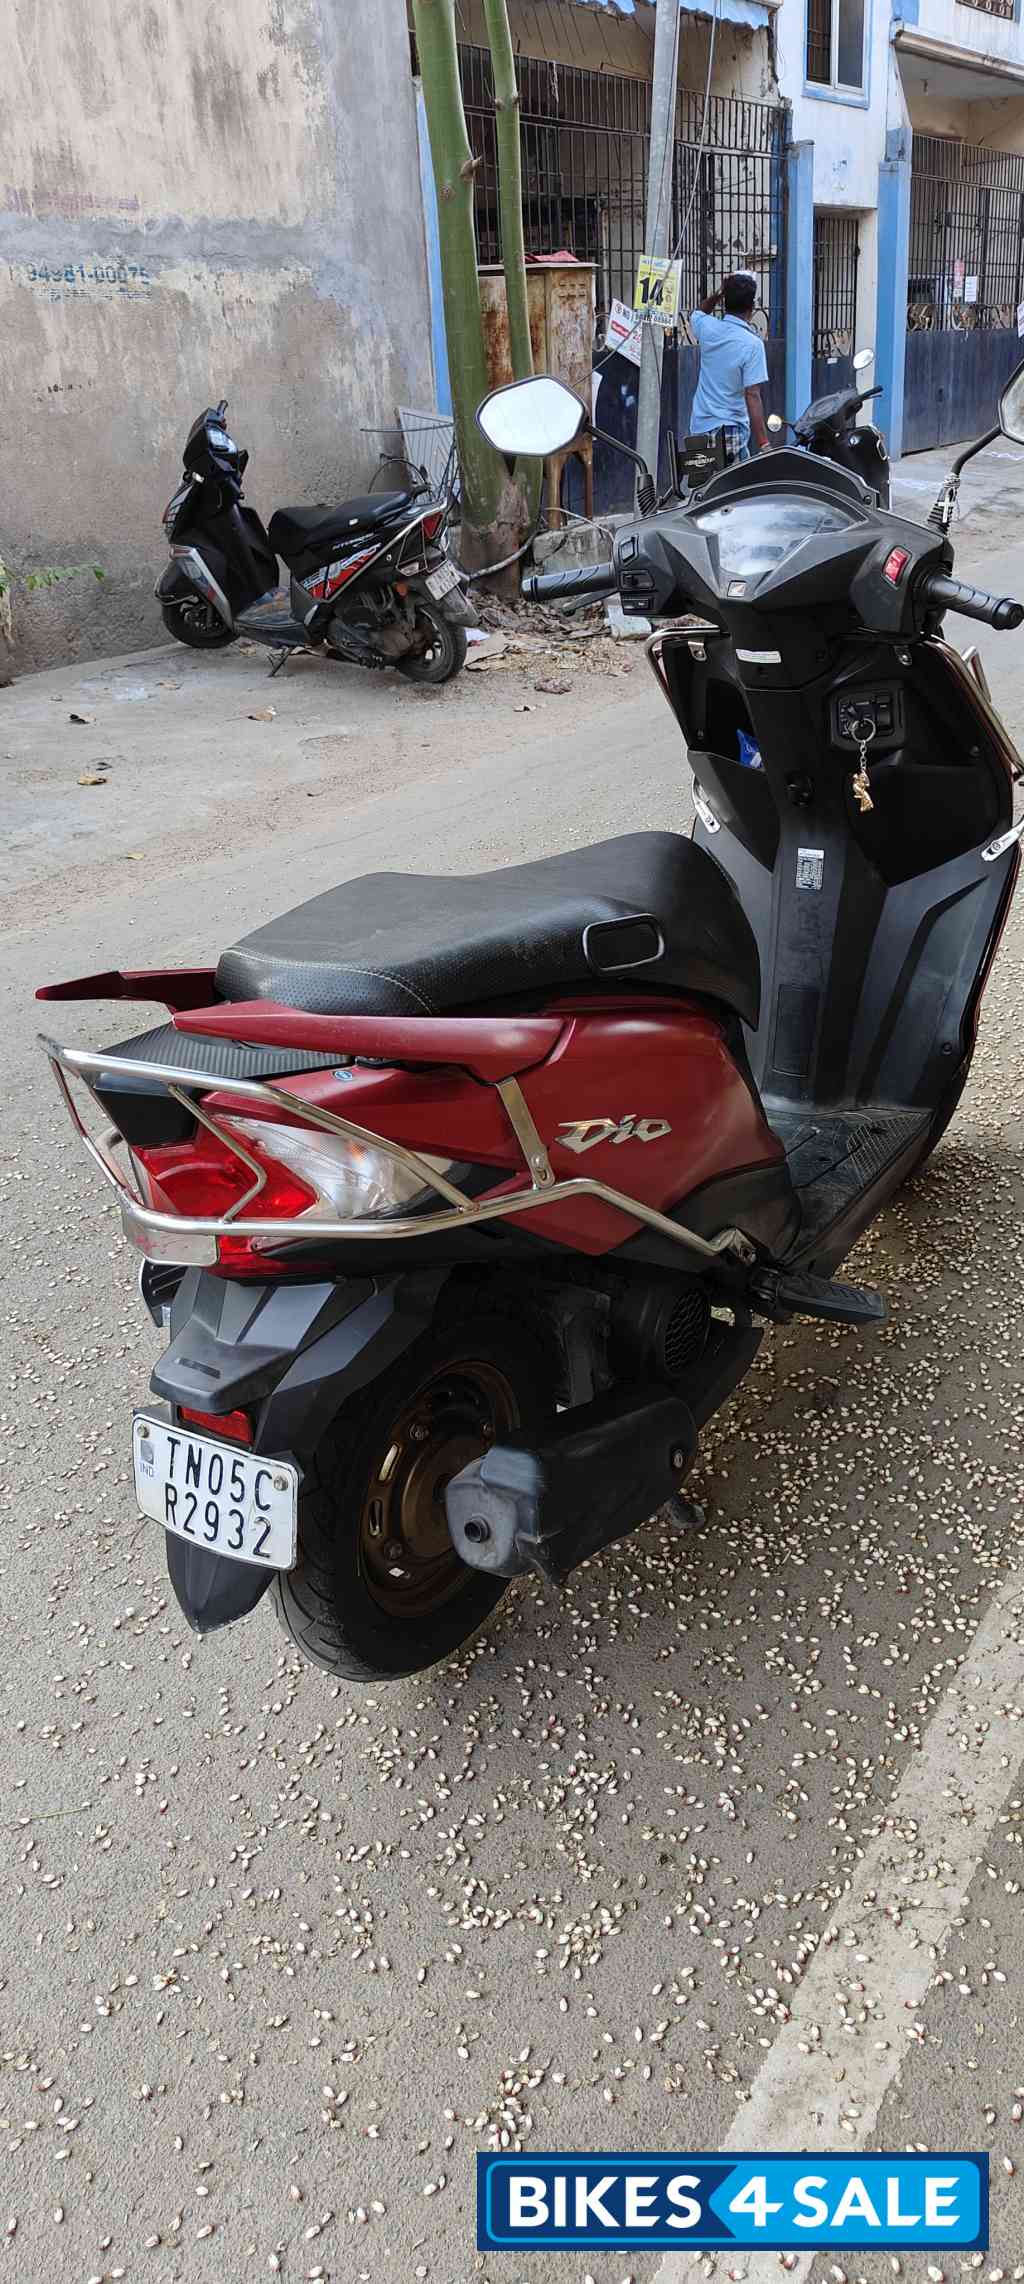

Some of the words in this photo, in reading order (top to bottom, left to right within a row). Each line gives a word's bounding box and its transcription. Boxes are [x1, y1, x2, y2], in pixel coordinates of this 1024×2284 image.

[639, 276, 664, 306] 14
[554, 1113, 673, 1154] Dio
[139, 1461, 155, 1478] IND
[167, 1436, 273, 1511] TN05C
[165, 1482, 272, 1559] R2932
